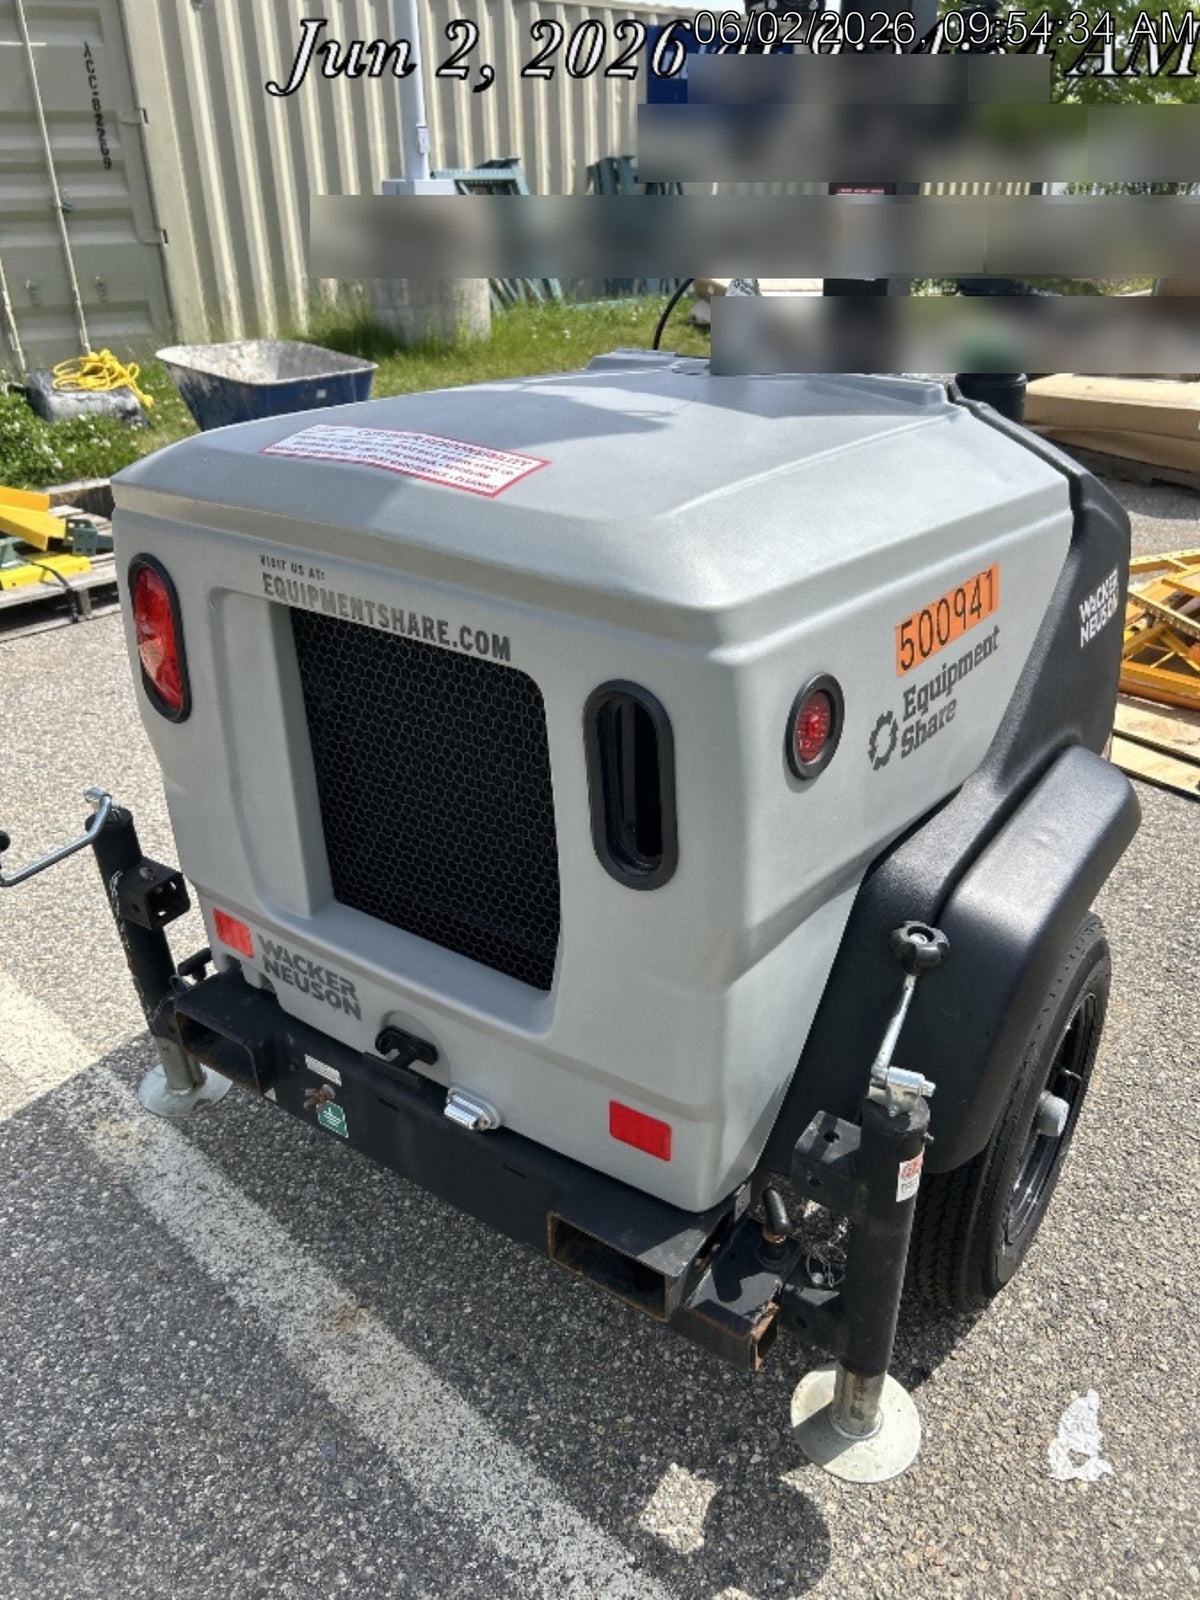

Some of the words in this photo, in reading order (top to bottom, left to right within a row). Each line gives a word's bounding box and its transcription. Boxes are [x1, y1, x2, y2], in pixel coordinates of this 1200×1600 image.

[259, 554, 287, 572] VISIT
[291, 562, 305, 576] US
[308, 567, 326, 581] AT:
[1079, 567, 1118, 623] WACKER
[262, 572, 513, 662] EQUIPMENTSHARE.COM
[900, 568, 994, 671] 500941
[1080, 587, 1119, 648] NEUSON
[902, 624, 1000, 722] Equipment
[901, 698, 957, 760] Share
[257, 933, 358, 1001] WACKER
[262, 954, 363, 1022] NEUSON
